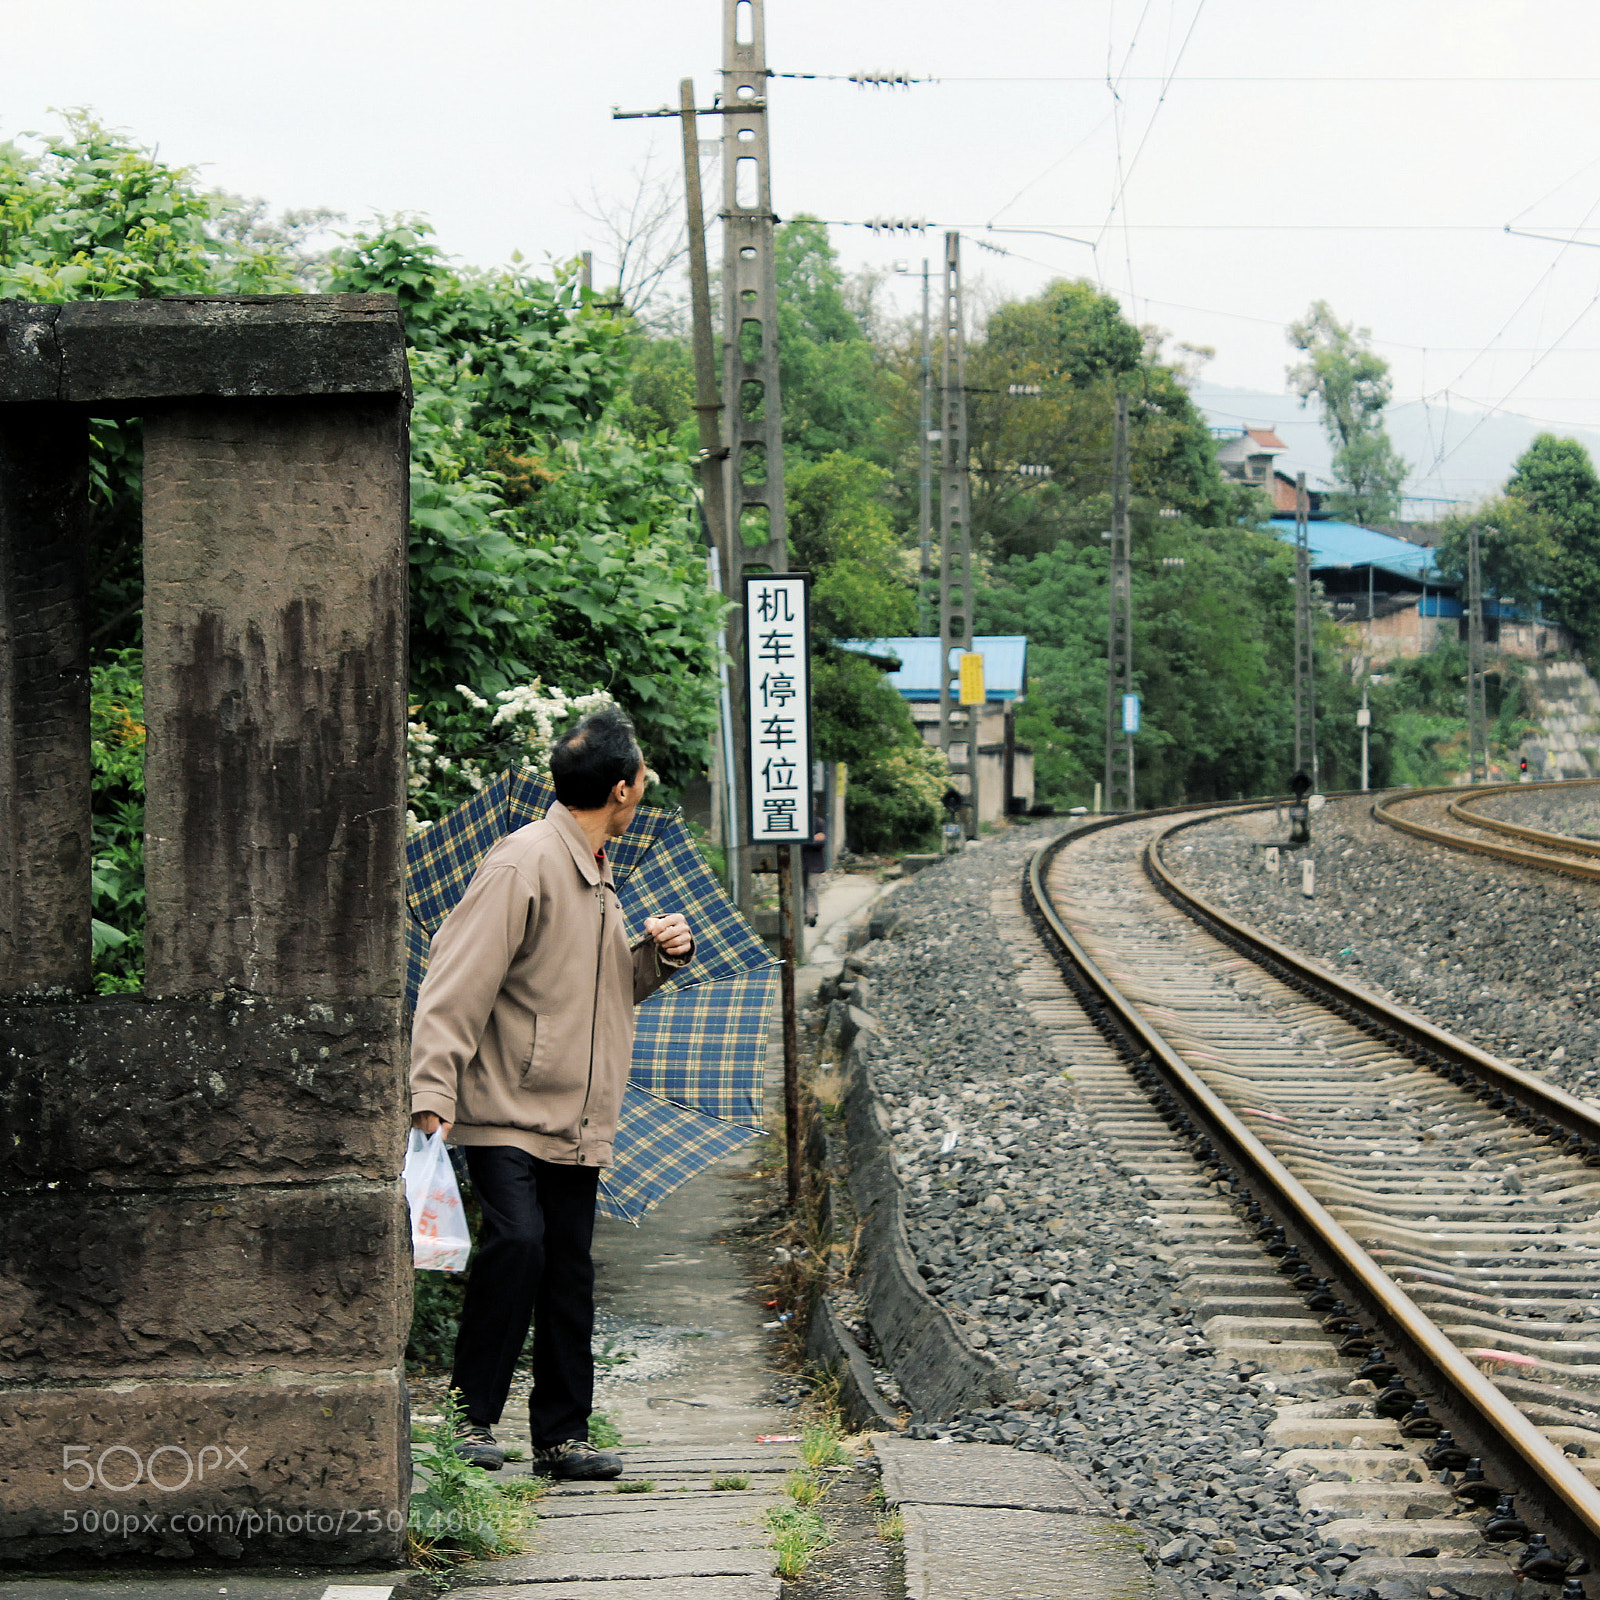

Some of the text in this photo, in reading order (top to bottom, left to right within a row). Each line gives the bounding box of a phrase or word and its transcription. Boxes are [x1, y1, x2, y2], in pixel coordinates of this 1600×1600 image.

[757, 587, 799, 833] 机车停车位置
